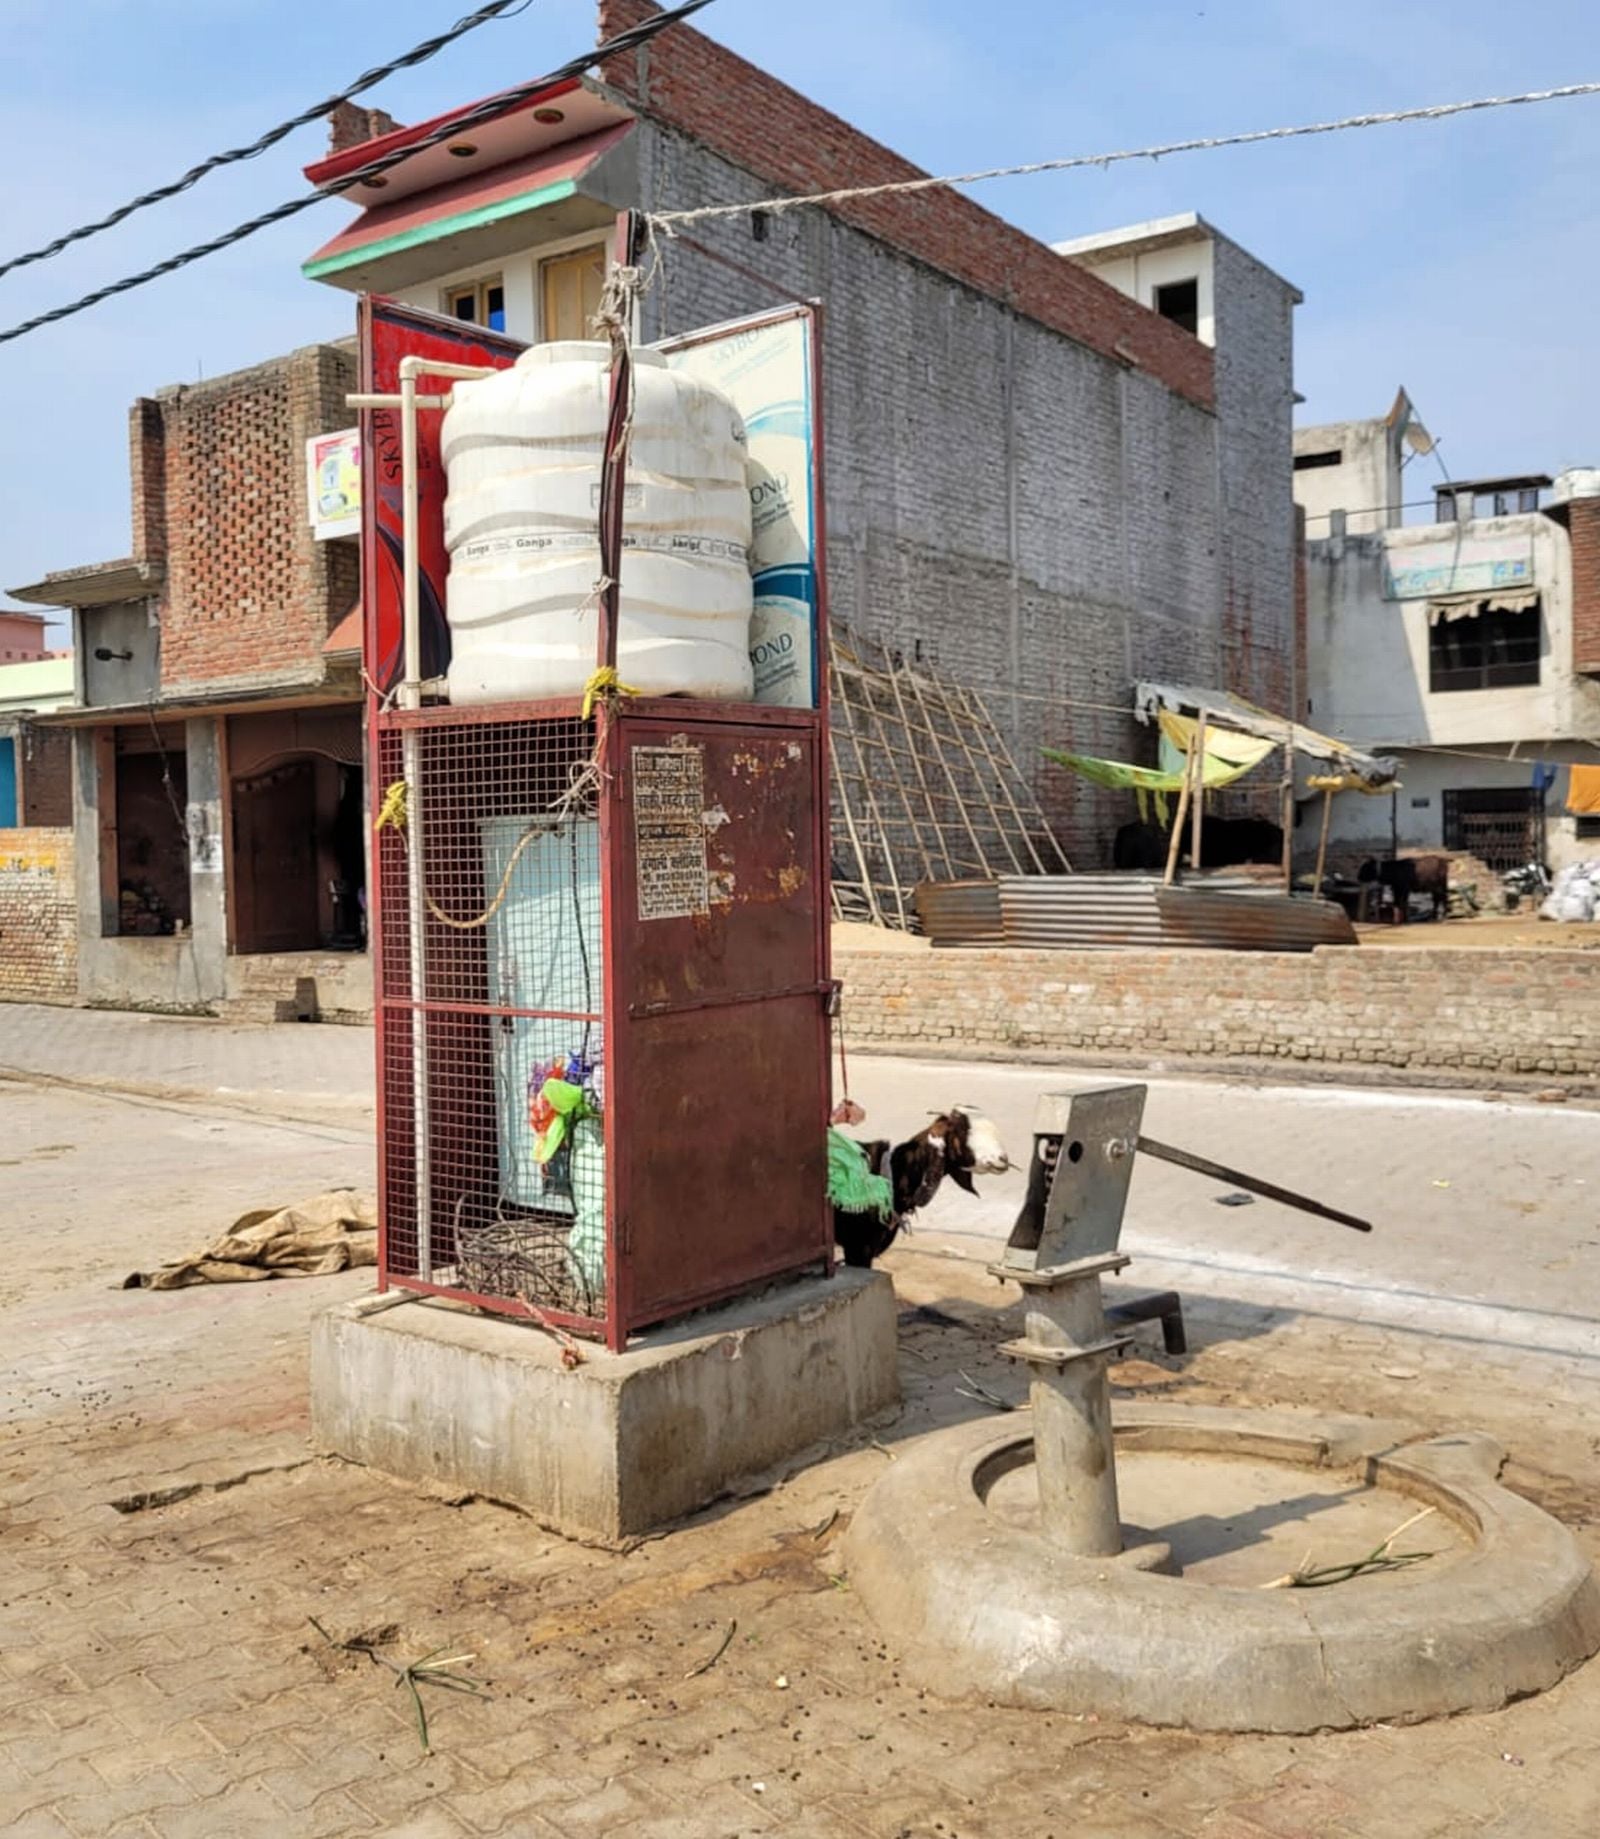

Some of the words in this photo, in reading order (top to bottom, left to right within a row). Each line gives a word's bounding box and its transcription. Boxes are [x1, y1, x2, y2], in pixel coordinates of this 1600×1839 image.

[374, 407, 402, 479] SKYB
[750, 473, 788, 505] OND
[516, 538, 553, 550] Ganga
